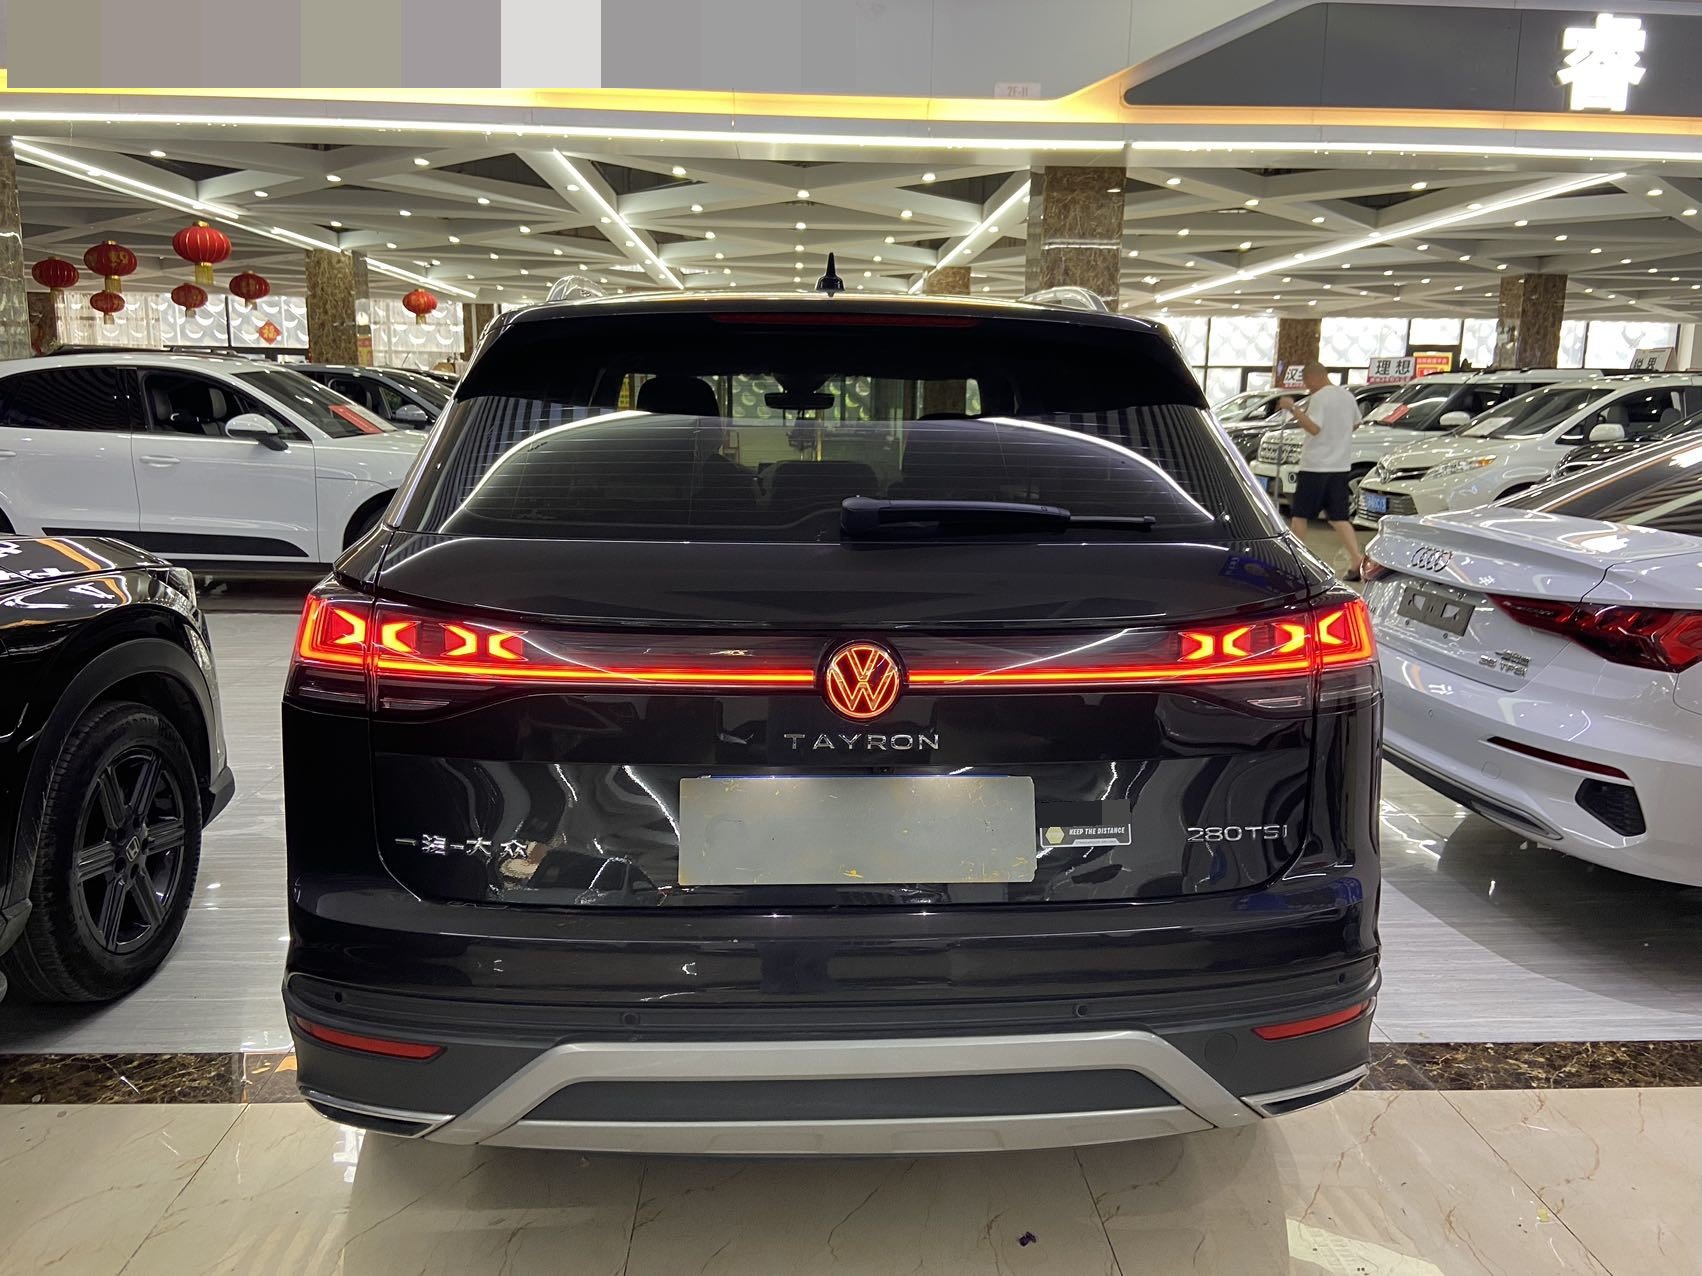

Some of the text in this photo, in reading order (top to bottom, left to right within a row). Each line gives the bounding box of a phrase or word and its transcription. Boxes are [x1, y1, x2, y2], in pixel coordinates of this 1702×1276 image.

[1374, 359, 1412, 376] 理想
[784, 733, 939, 750] TAYRON
[1069, 826, 1125, 836] KEEP THE DISTANCE
